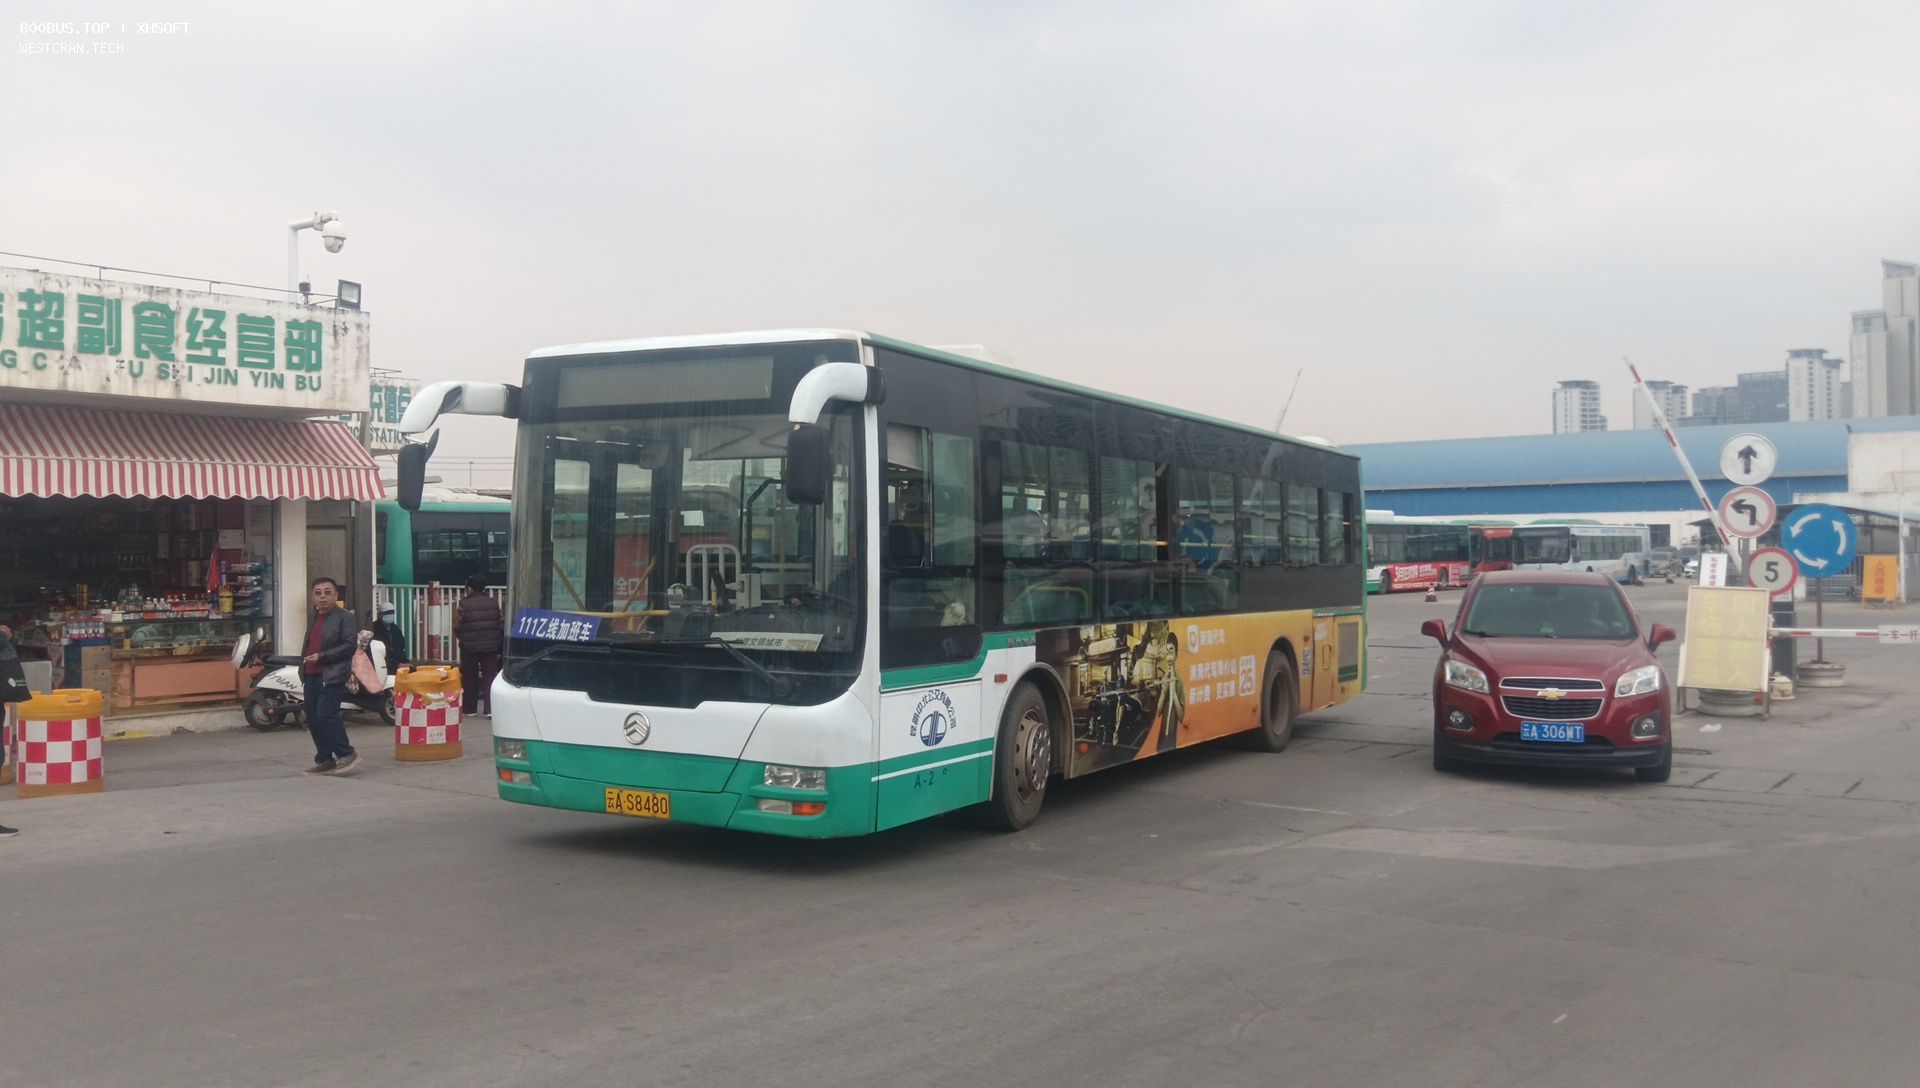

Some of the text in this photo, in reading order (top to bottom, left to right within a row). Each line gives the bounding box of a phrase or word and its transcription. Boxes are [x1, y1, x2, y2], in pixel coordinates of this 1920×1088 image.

[0, 288, 322, 373] 超副食经营部
[204, 367, 238, 386] JIN
[249, 370, 284, 389] YIN
[295, 375, 322, 392] BU
[1764, 561, 1779, 583] 5
[519, 616, 593, 642] 111乙线加班车
